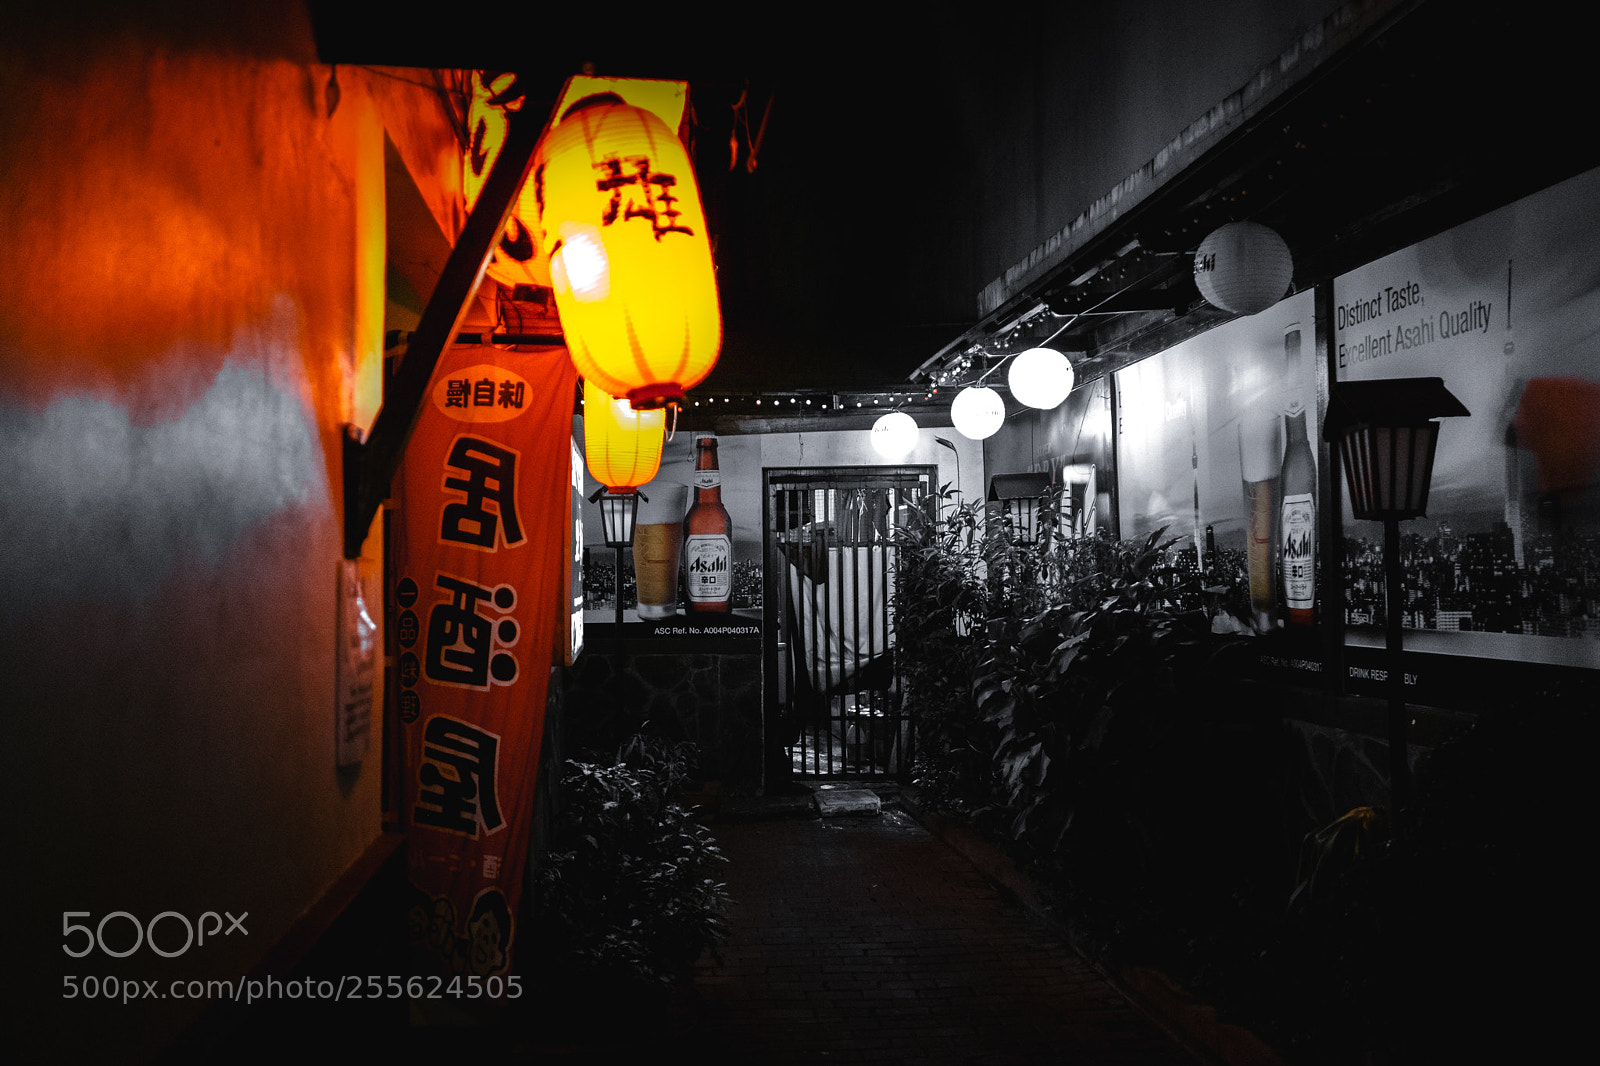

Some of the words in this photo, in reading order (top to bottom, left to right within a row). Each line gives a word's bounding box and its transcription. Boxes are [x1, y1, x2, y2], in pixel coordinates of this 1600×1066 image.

[1337, 291, 1382, 331] Distinct
[1384, 280, 1425, 315] Taste,
[1338, 328, 1392, 369] Excellent
[1394, 314, 1435, 352] Asahi
[1439, 300, 1492, 340] Quality
[1283, 529, 1312, 559] Asahi
[689, 555, 728, 573] Asahi
[654, 627, 671, 635] ASC
[673, 627, 688, 635] Ref.
[689, 627, 702, 635] No.
[704, 626, 760, 635] A004P040317A
[1349, 666, 1370, 679] DRINK
